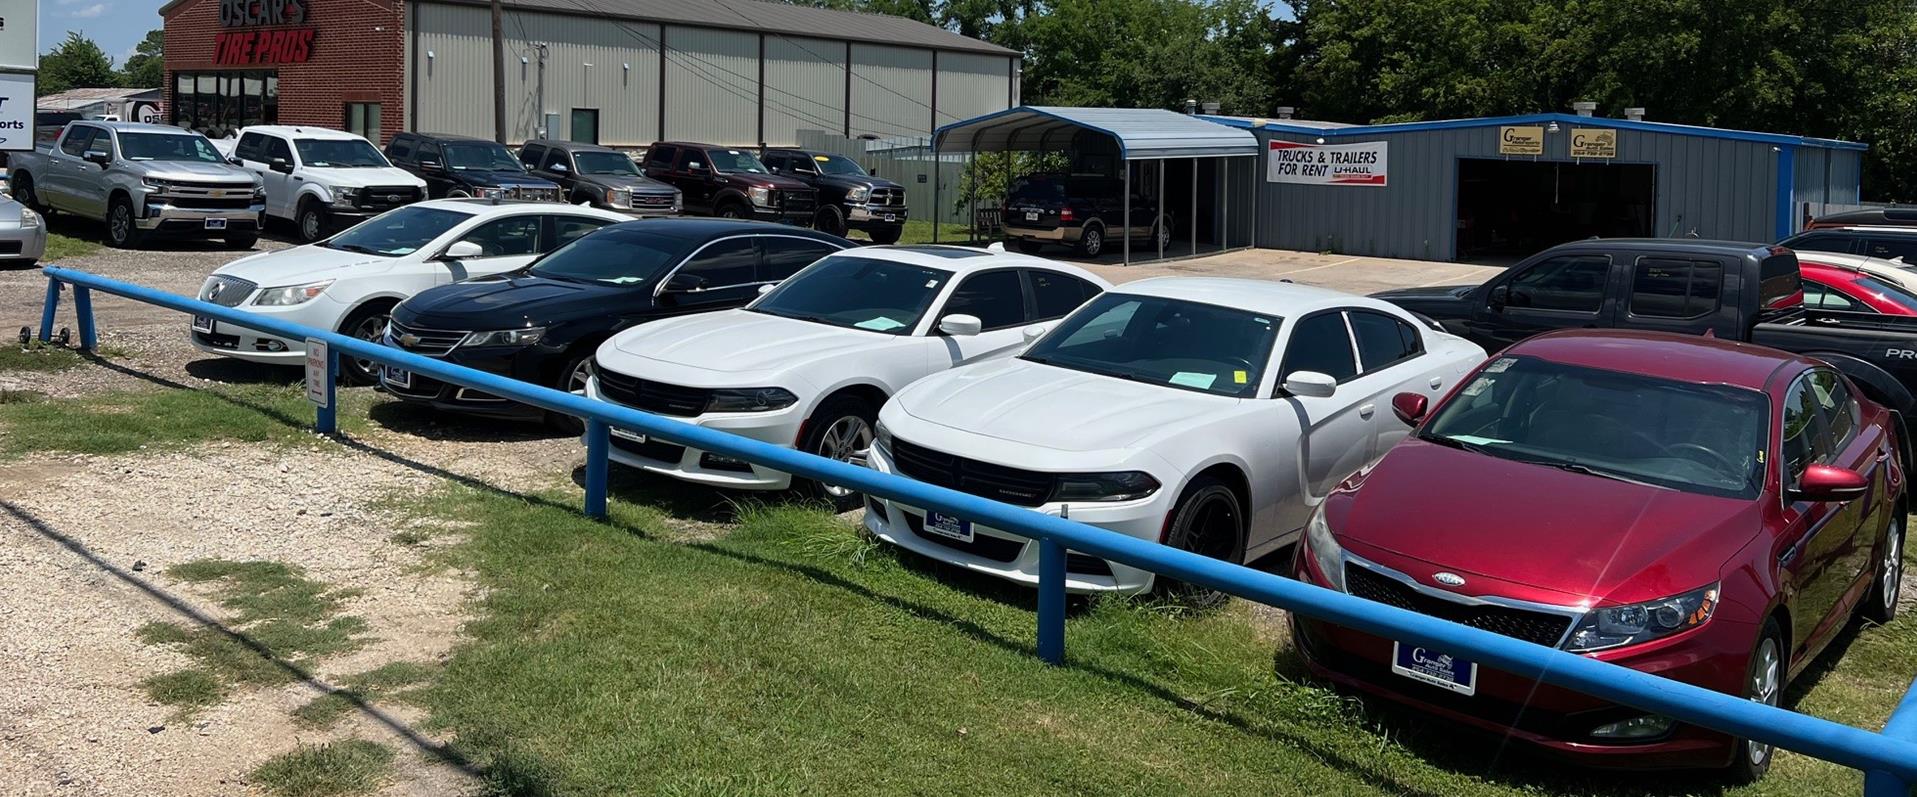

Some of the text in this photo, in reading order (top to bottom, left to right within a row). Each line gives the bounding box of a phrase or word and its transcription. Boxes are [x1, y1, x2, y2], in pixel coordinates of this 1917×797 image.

[219, 0, 305, 27] OSCAR'S
[211, 28, 316, 65] TIRE PROS
[1573, 134, 1606, 148] Granger
[1277, 150, 1378, 165] TRUCKS & TRAILERS
[1277, 163, 1329, 177] FOR RENT
[1333, 166, 1372, 174] U-HAUL
[1412, 647, 1447, 668] Granger
